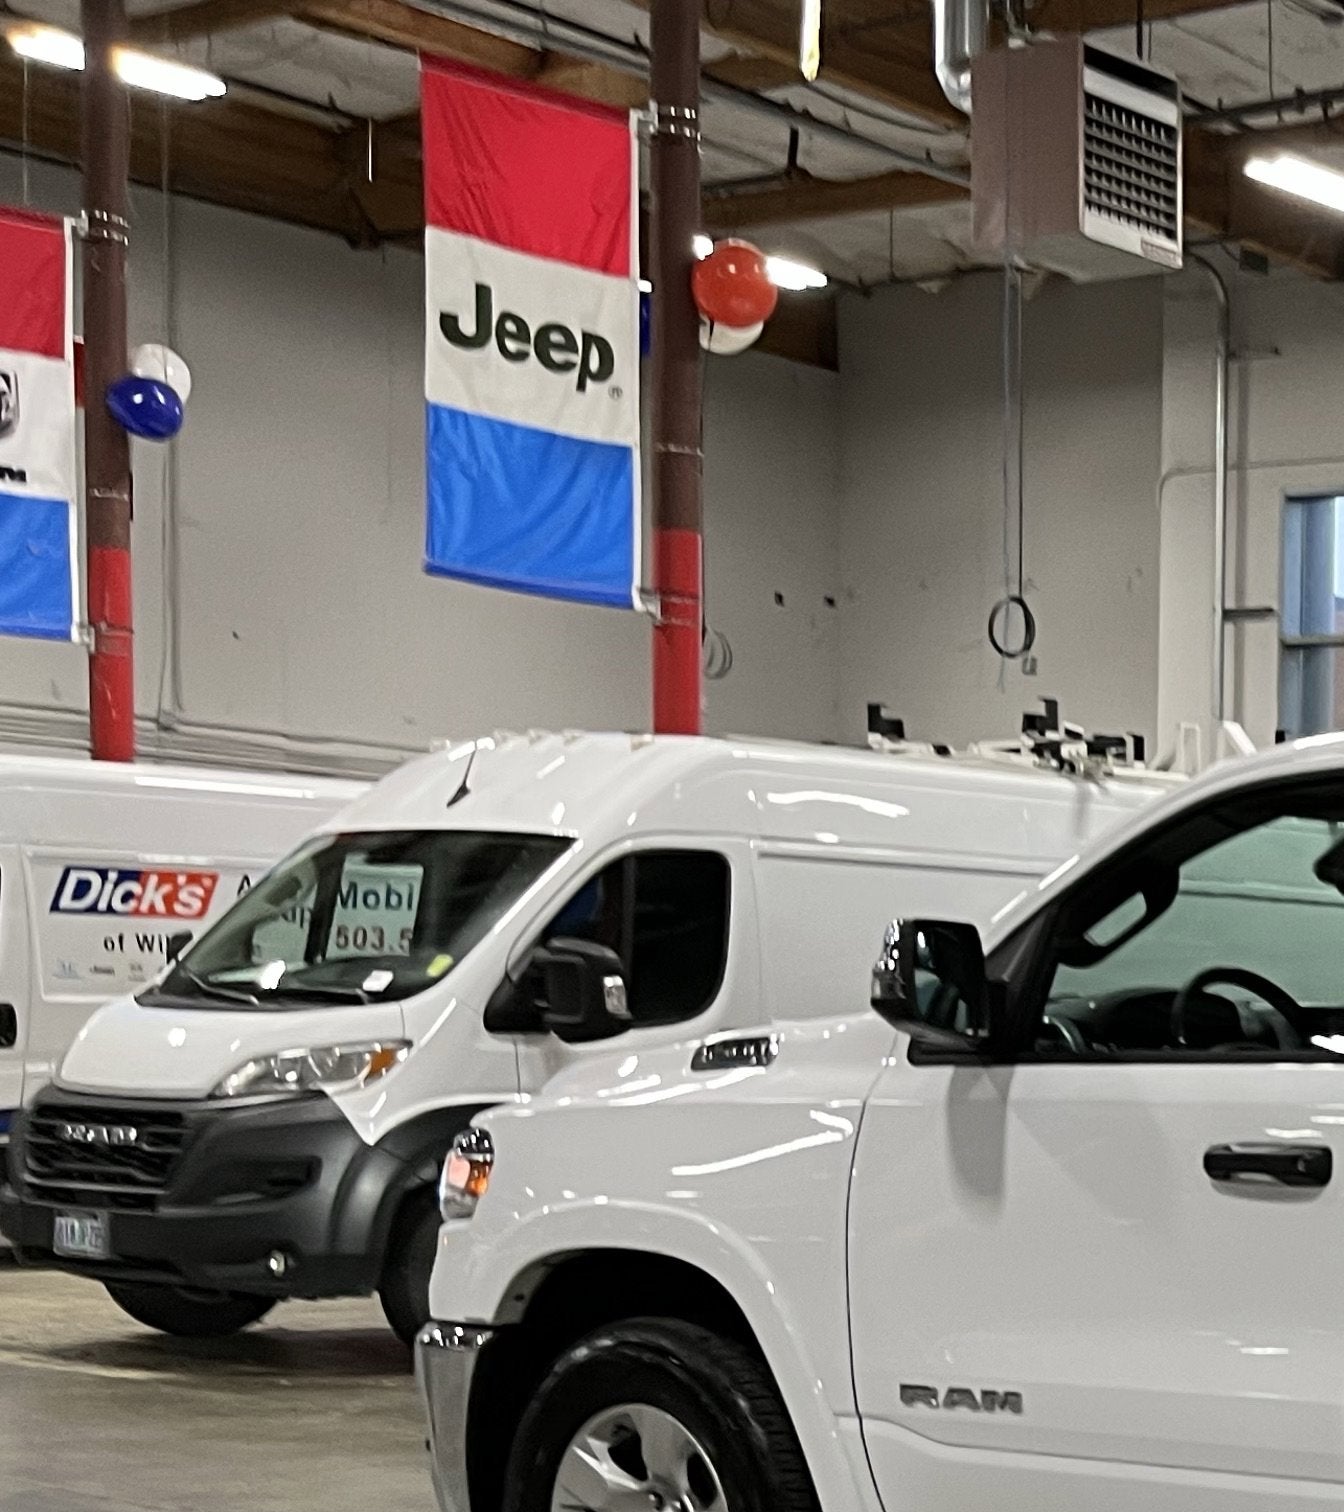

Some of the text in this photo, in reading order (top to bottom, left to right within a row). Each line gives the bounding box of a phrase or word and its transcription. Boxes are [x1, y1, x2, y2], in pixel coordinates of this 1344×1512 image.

[439, 281, 615, 393] Jeep
[58, 868, 206, 917] Dick's
[899, 1383, 1023, 1415] RAM
